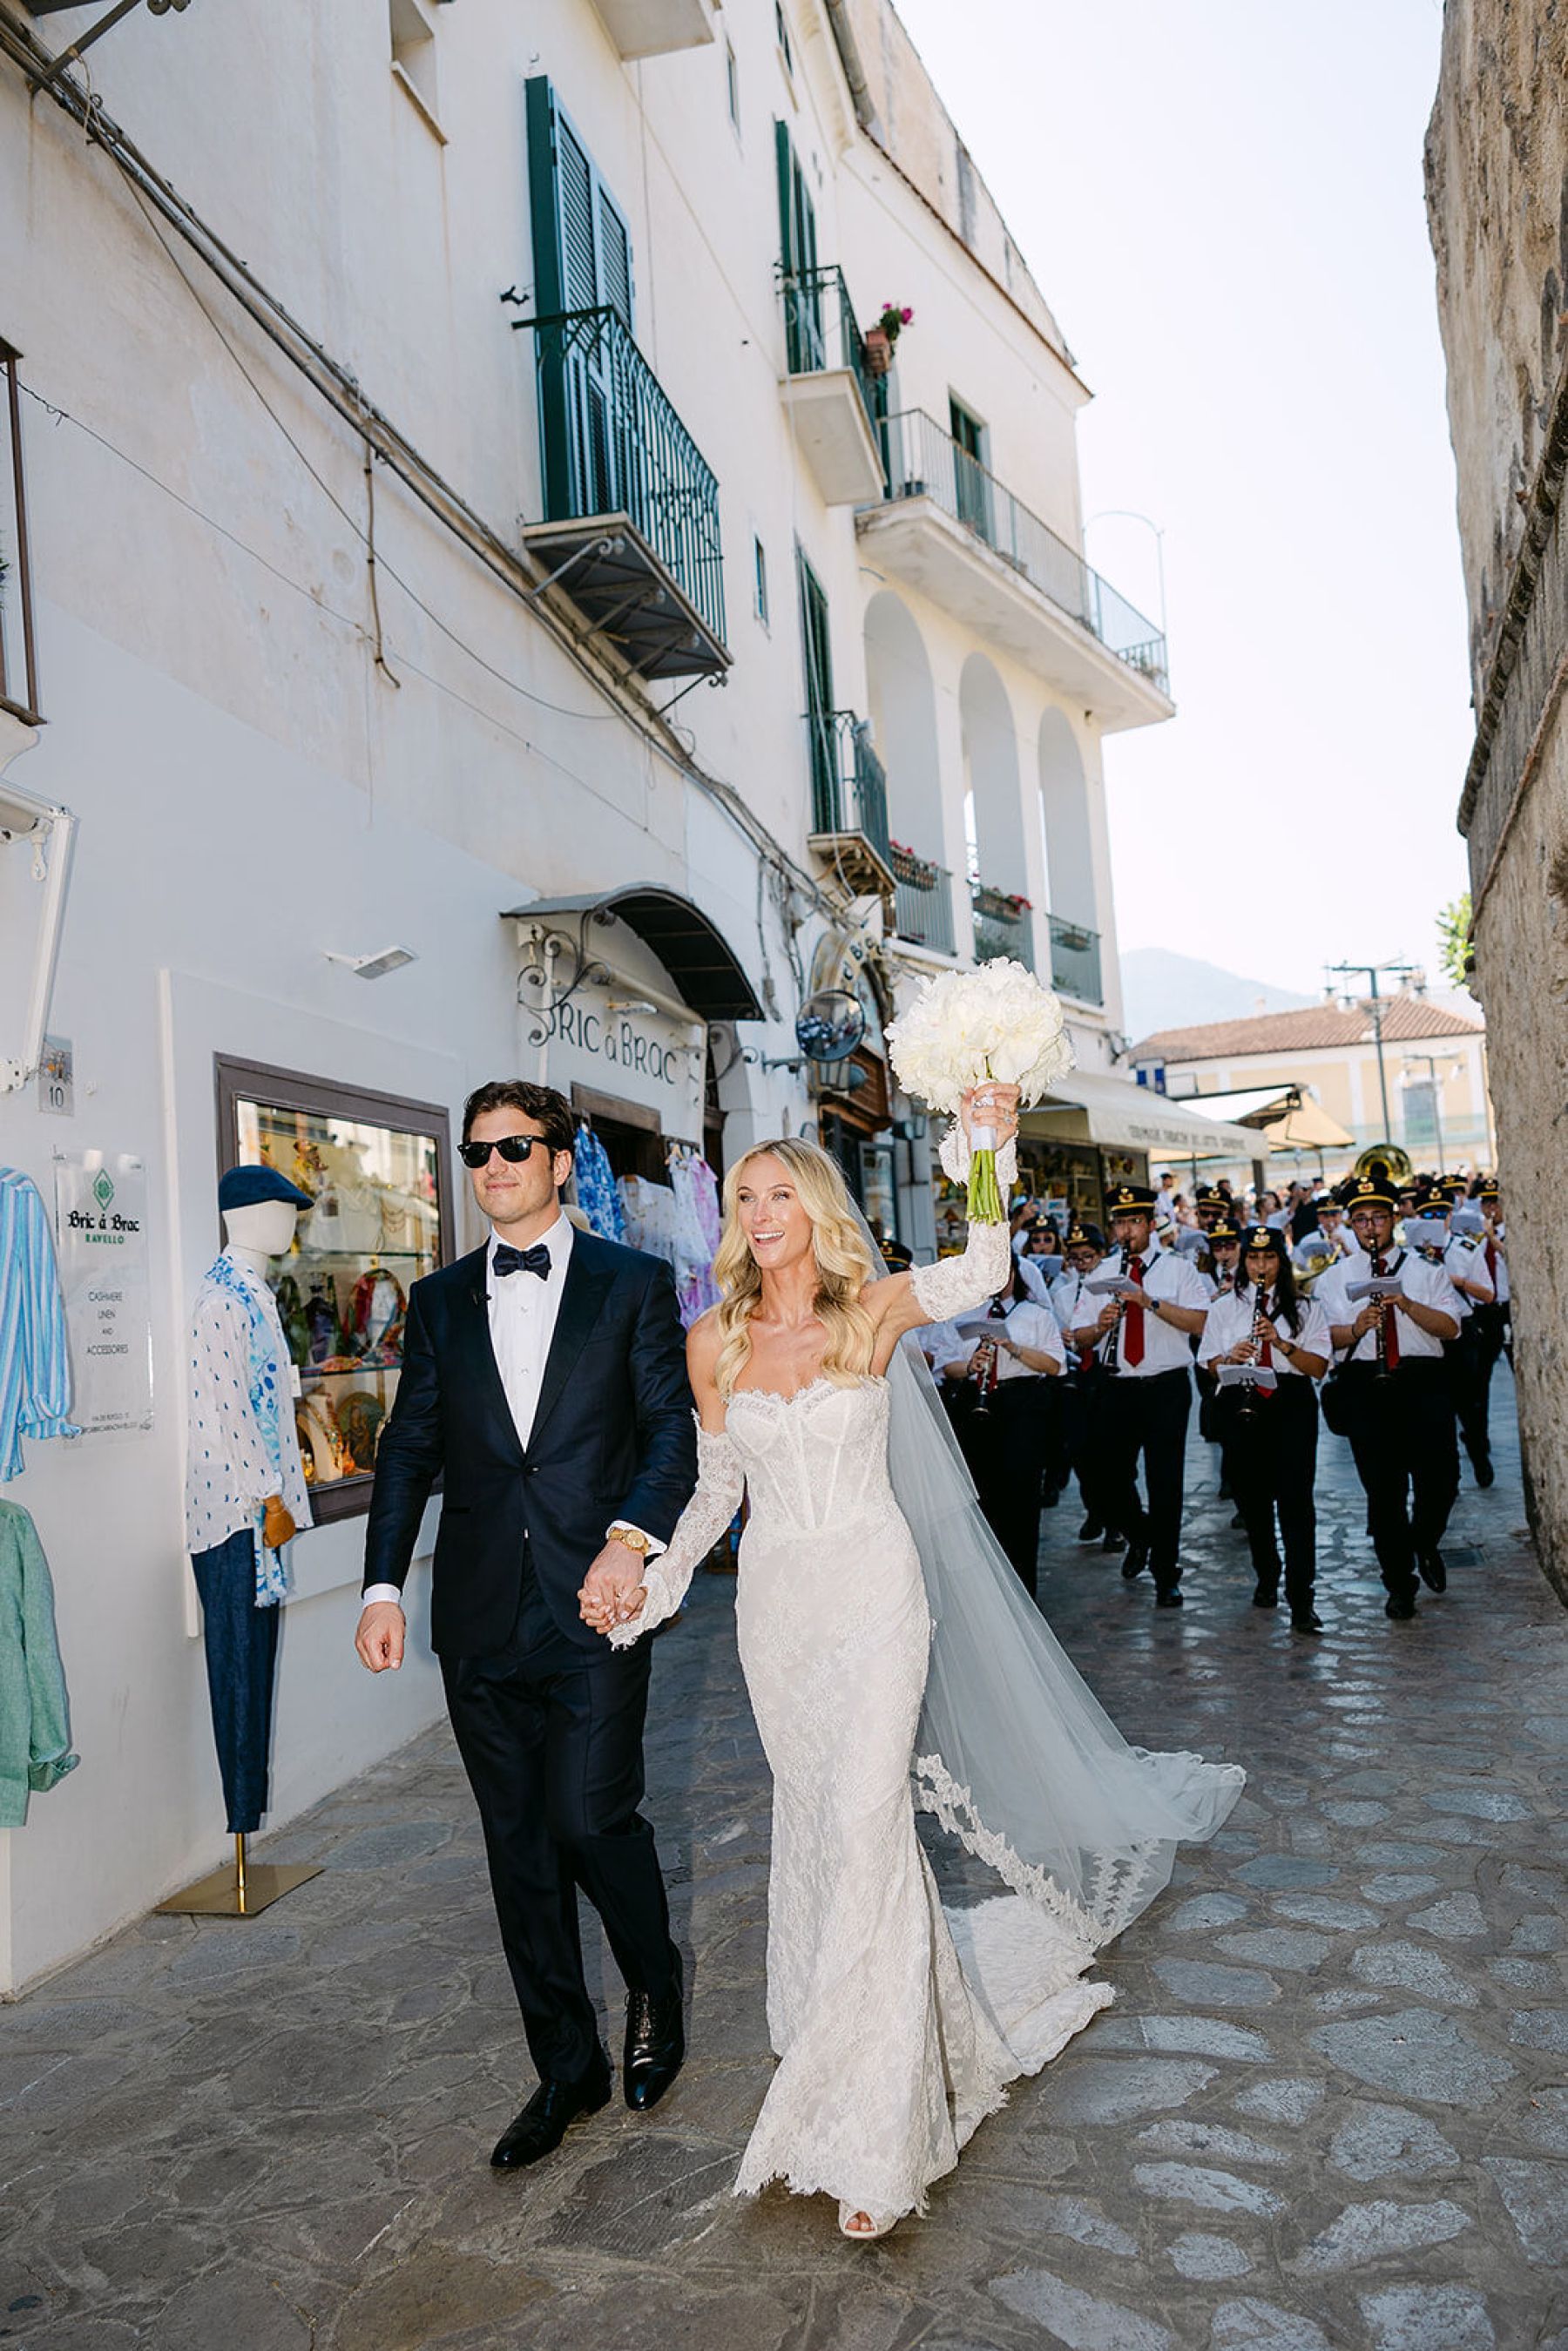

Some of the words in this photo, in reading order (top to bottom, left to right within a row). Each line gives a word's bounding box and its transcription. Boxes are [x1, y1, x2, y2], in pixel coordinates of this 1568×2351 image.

[50, 1086, 64, 1107] 10
[67, 1210, 95, 1229] Bric
[112, 1213, 139, 1232] Brac
[85, 1233, 124, 1244] RAVELLO
